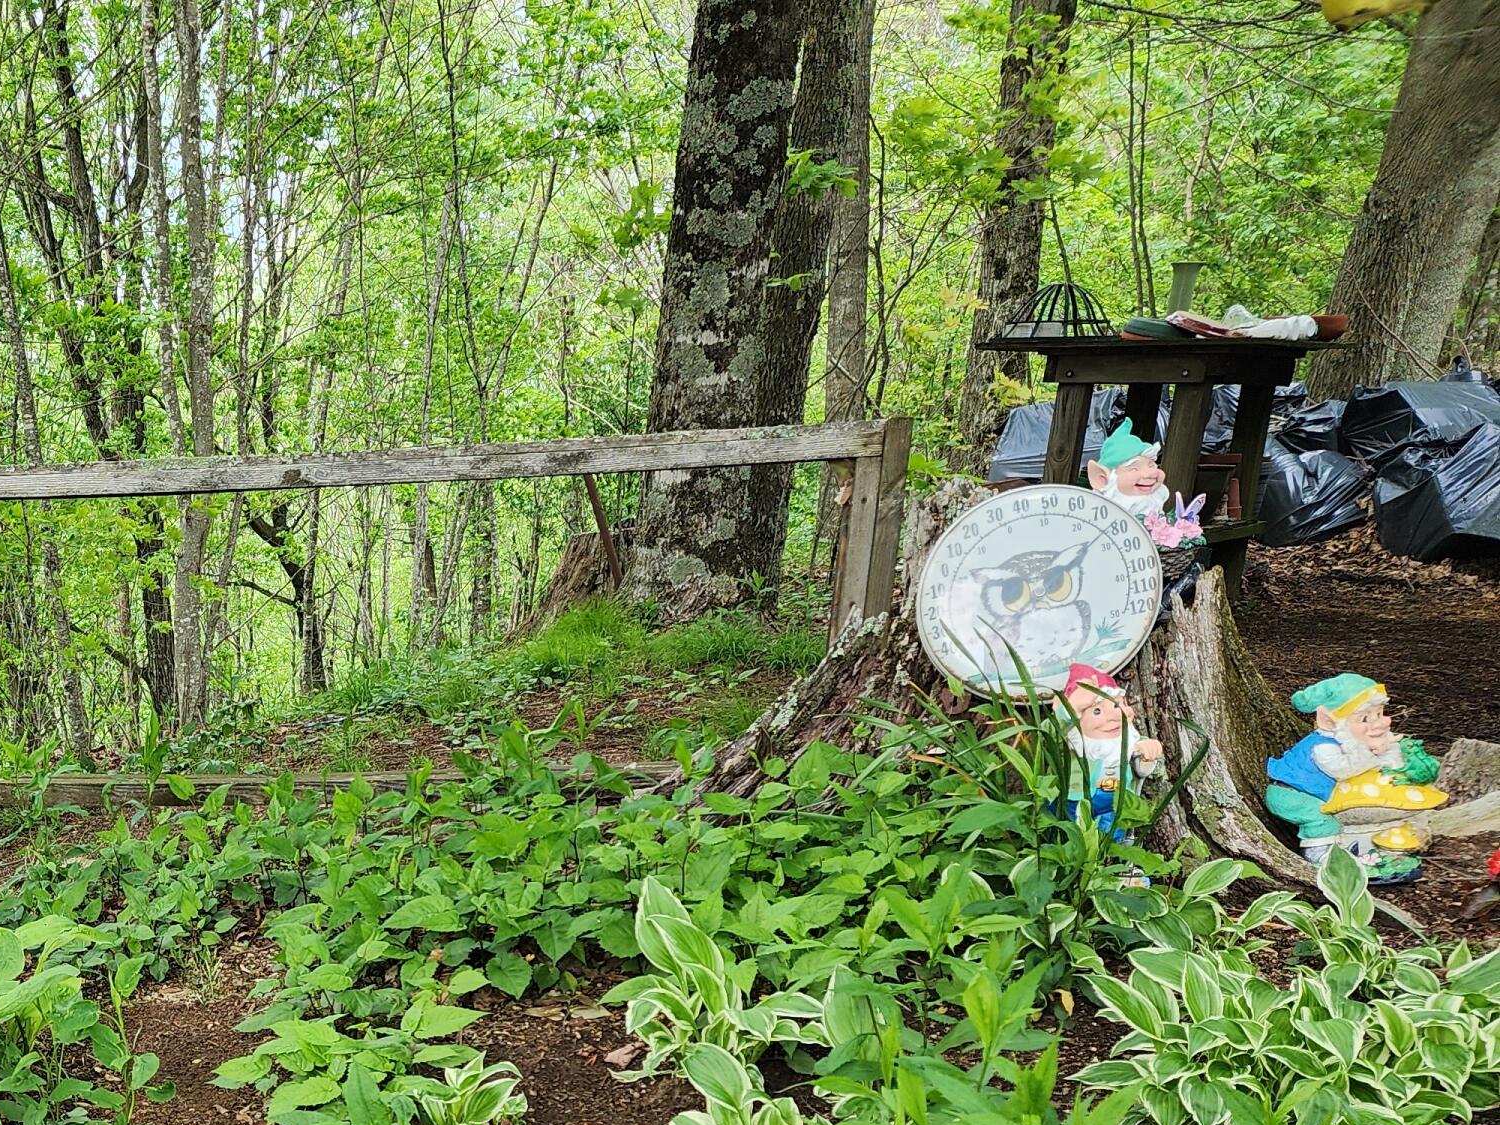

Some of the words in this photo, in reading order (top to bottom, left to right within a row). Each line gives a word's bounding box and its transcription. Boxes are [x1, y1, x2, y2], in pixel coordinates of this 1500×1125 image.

[1013, 498, 1030, 513] 40
[1041, 494, 1058, 509] 50
[1068, 495, 1085, 511] 60
[986, 508, 1003, 524] 30
[1092, 505, 1108, 521] 70
[1040, 518, 1049, 527] 10
[1073, 523, 1082, 532] 20
[1111, 519, 1128, 536] 80
[963, 523, 979, 540] 20
[947, 543, 962, 558] 10
[1101, 542, 1111, 552] 30
[1123, 536, 1141, 553] 90
[941, 563, 949, 577] 0
[1130, 555, 1155, 573] 100
[925, 583, 945, 600] -10
[1132, 576, 1157, 594] 110
[1110, 609, 1120, 619] 50
[1130, 597, 1155, 616] 120
